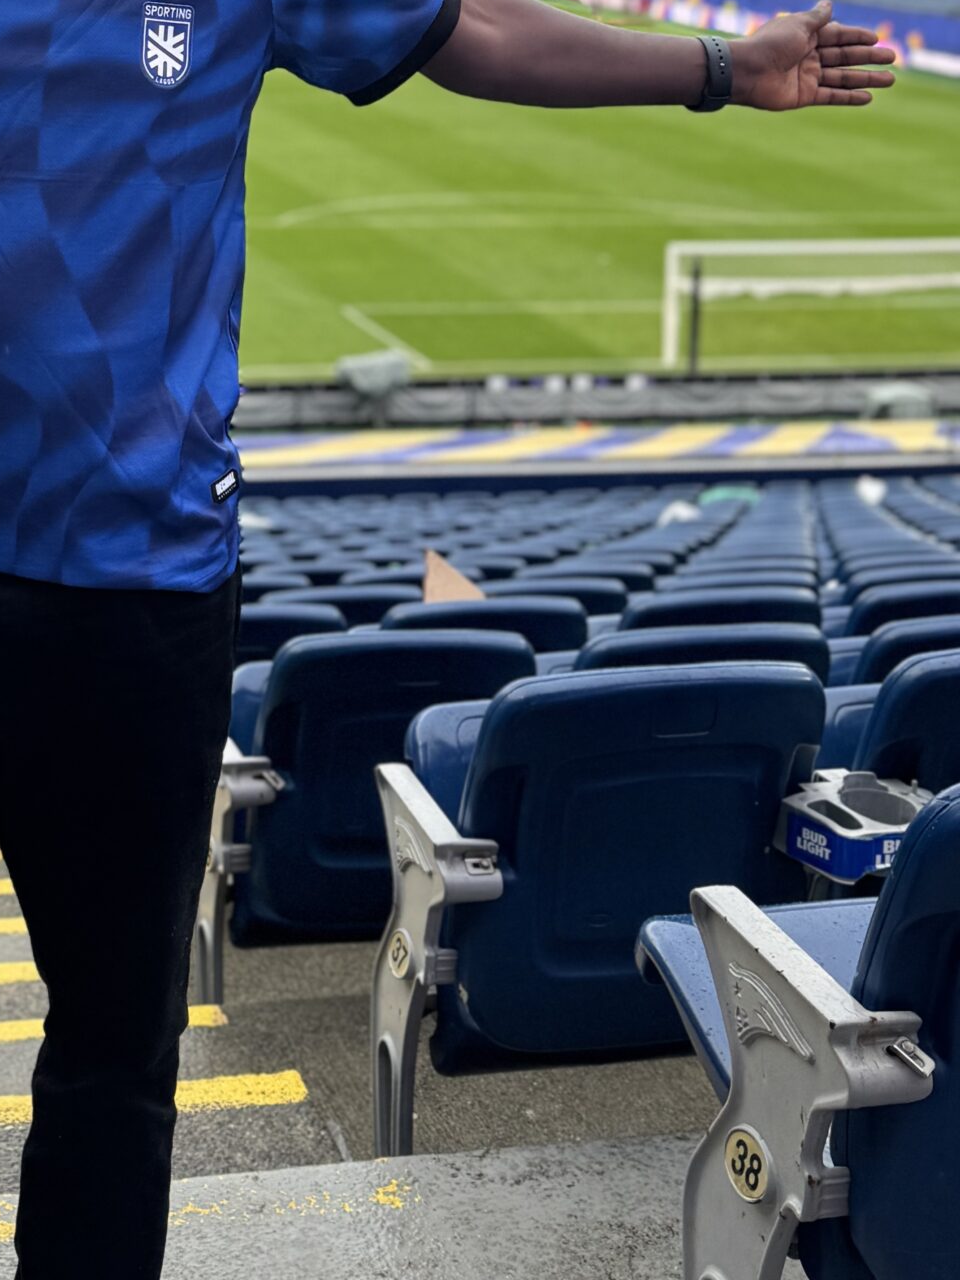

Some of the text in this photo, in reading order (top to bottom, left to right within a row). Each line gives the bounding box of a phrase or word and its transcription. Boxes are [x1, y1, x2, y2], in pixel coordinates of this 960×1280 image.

[145, 5, 192, 19] SPORTING
[797, 836, 831, 860] LIGHT
[802, 827, 827, 846] BUD
[392, 937, 408, 968] 37
[731, 1139, 762, 1191] 38
